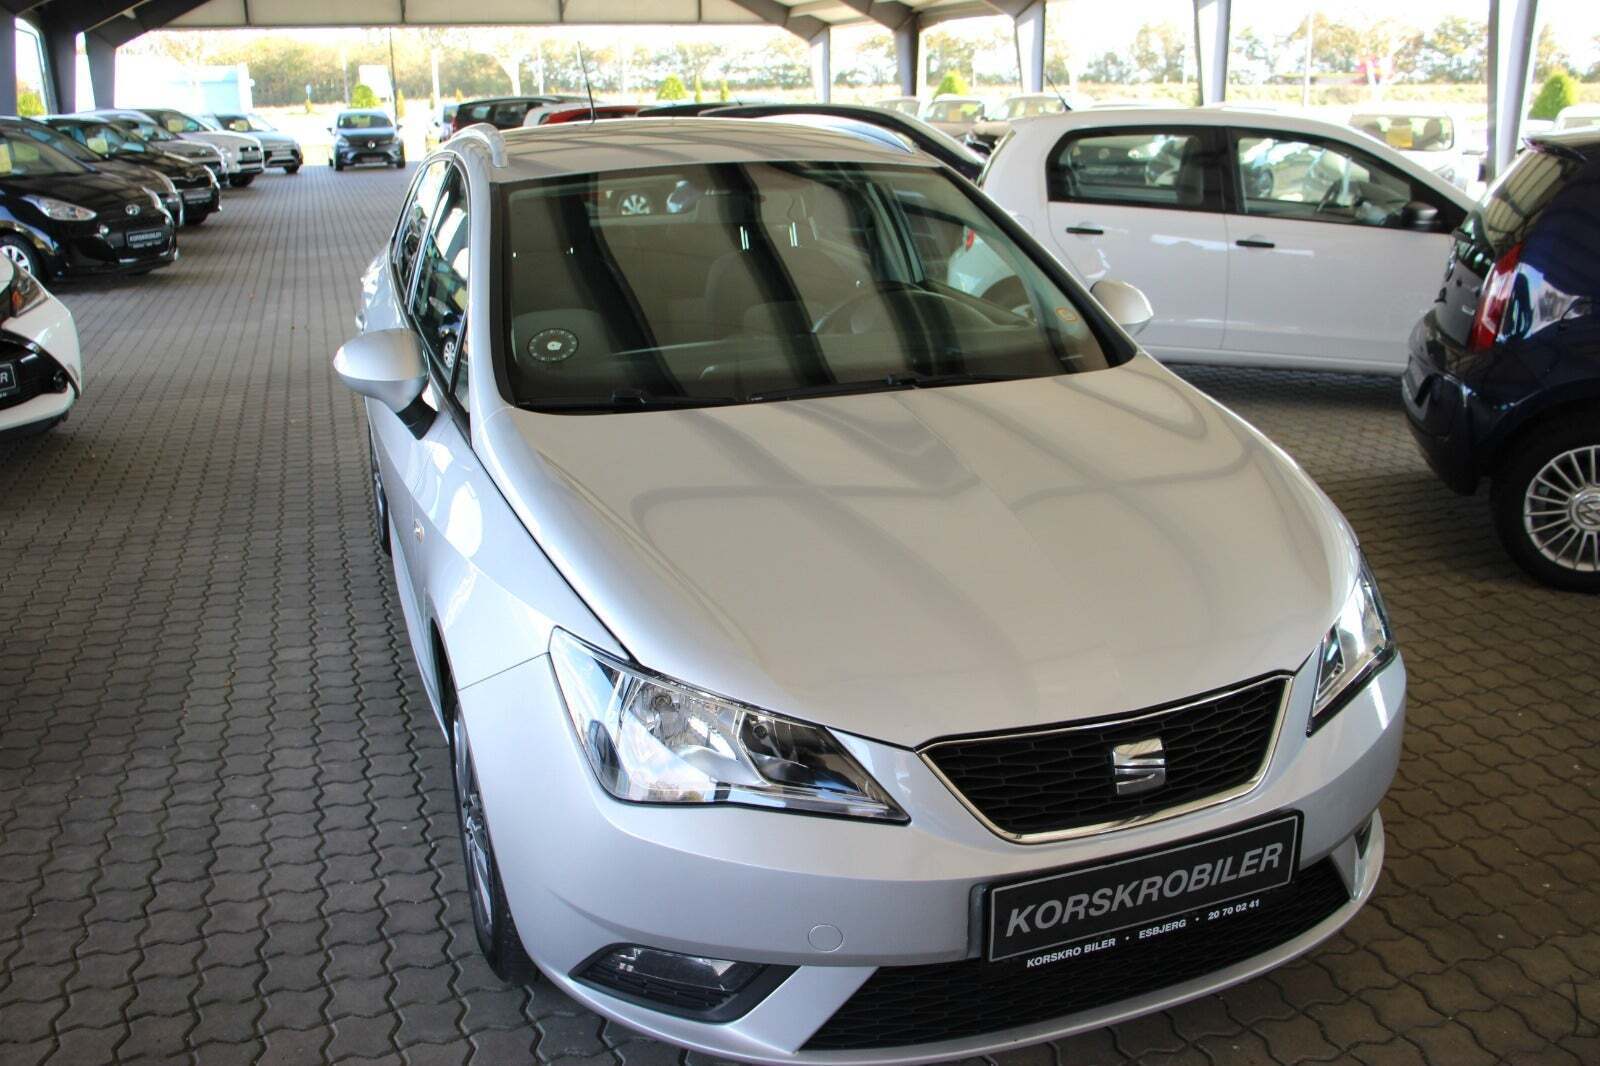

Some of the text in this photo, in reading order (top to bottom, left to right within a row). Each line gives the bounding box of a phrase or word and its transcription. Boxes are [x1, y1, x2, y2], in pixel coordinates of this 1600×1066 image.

[1006, 843, 1283, 937] KORSKROBILER
[1026, 899, 1260, 968] KORSKRO BILER ESBJERG 20 70 02 41
